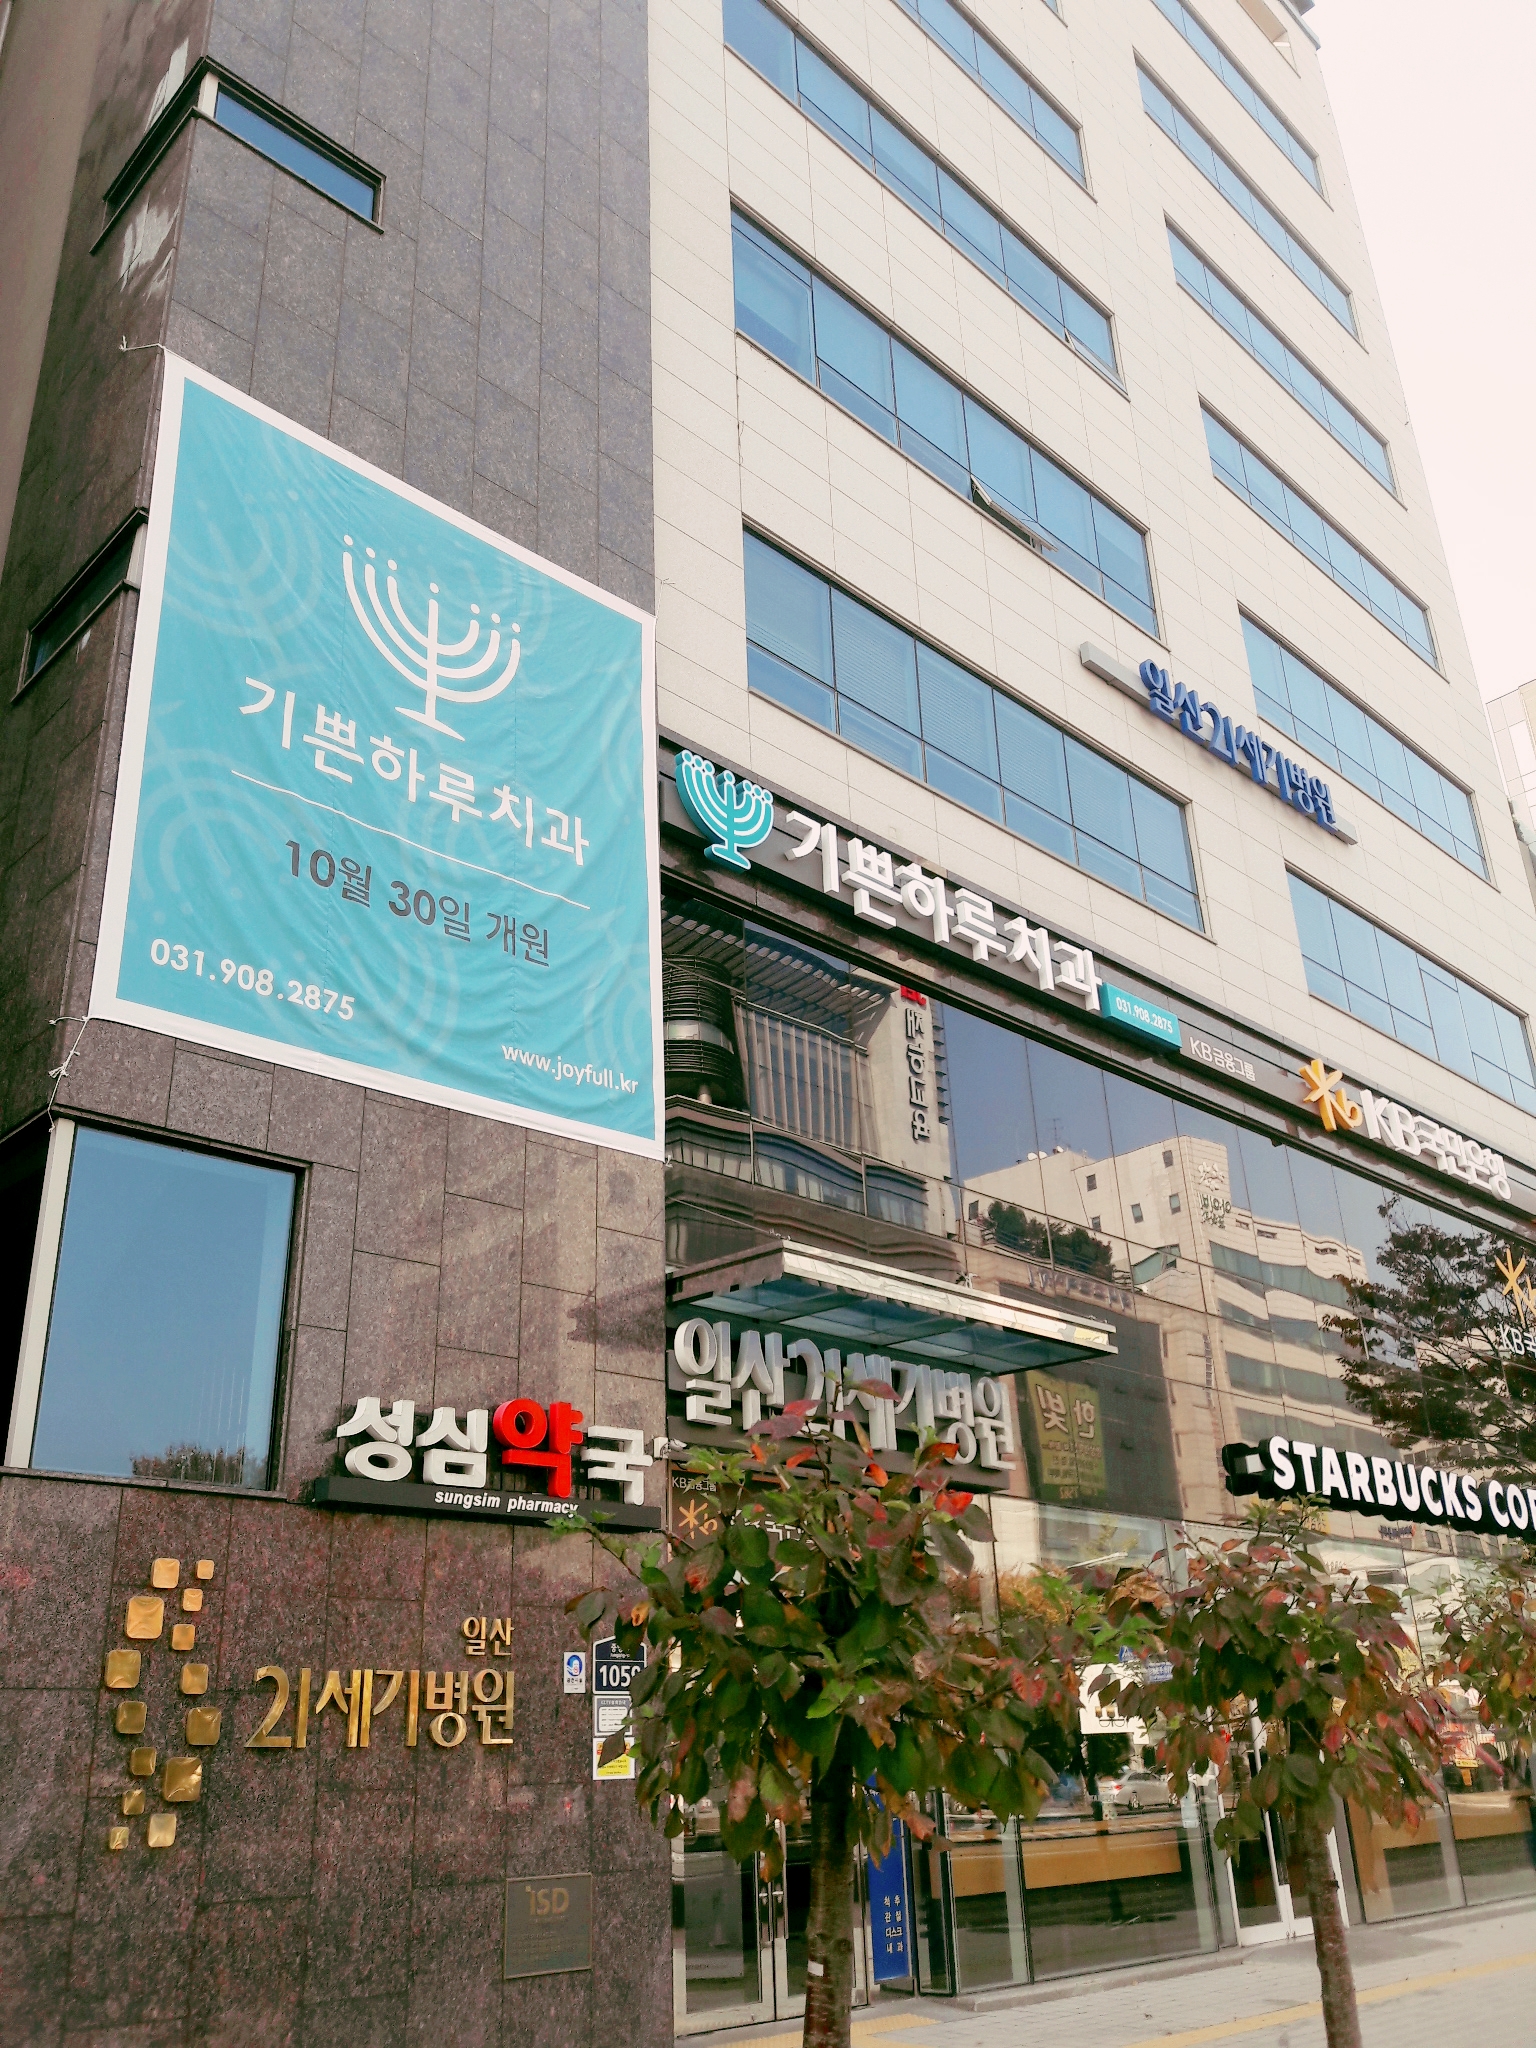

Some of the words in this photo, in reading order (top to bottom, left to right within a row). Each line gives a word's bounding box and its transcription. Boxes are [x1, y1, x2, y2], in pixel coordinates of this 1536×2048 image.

[239, 676, 589, 866] 기쁜하루치과
[286, 840, 372, 908] 10월
[388, 879, 471, 943] 30일
[486, 911, 550, 967] 개원
[784, 810, 1102, 1012] 기쁜하루치과
[149, 938, 356, 1021] 031.908.2875
[1115, 996, 1174, 1034] 031.908.2875
[500, 1043, 640, 1095] www.joyfull.kr
[1189, 1036, 1256, 1082] KB금융그룹
[1360, 1089, 1512, 1200] KB국민은행
[336, 1396, 654, 1506] 성심약국
[1268, 1435, 1483, 1522] STARBUCKS
[434, 1488, 501, 1510] sungsim
[507, 1496, 579, 1518] pharmacy
[462, 1615, 515, 1657] 일산
[244, 1665, 515, 1748] 21세기병원
[886, 1926, 903, 1938] 디스크
